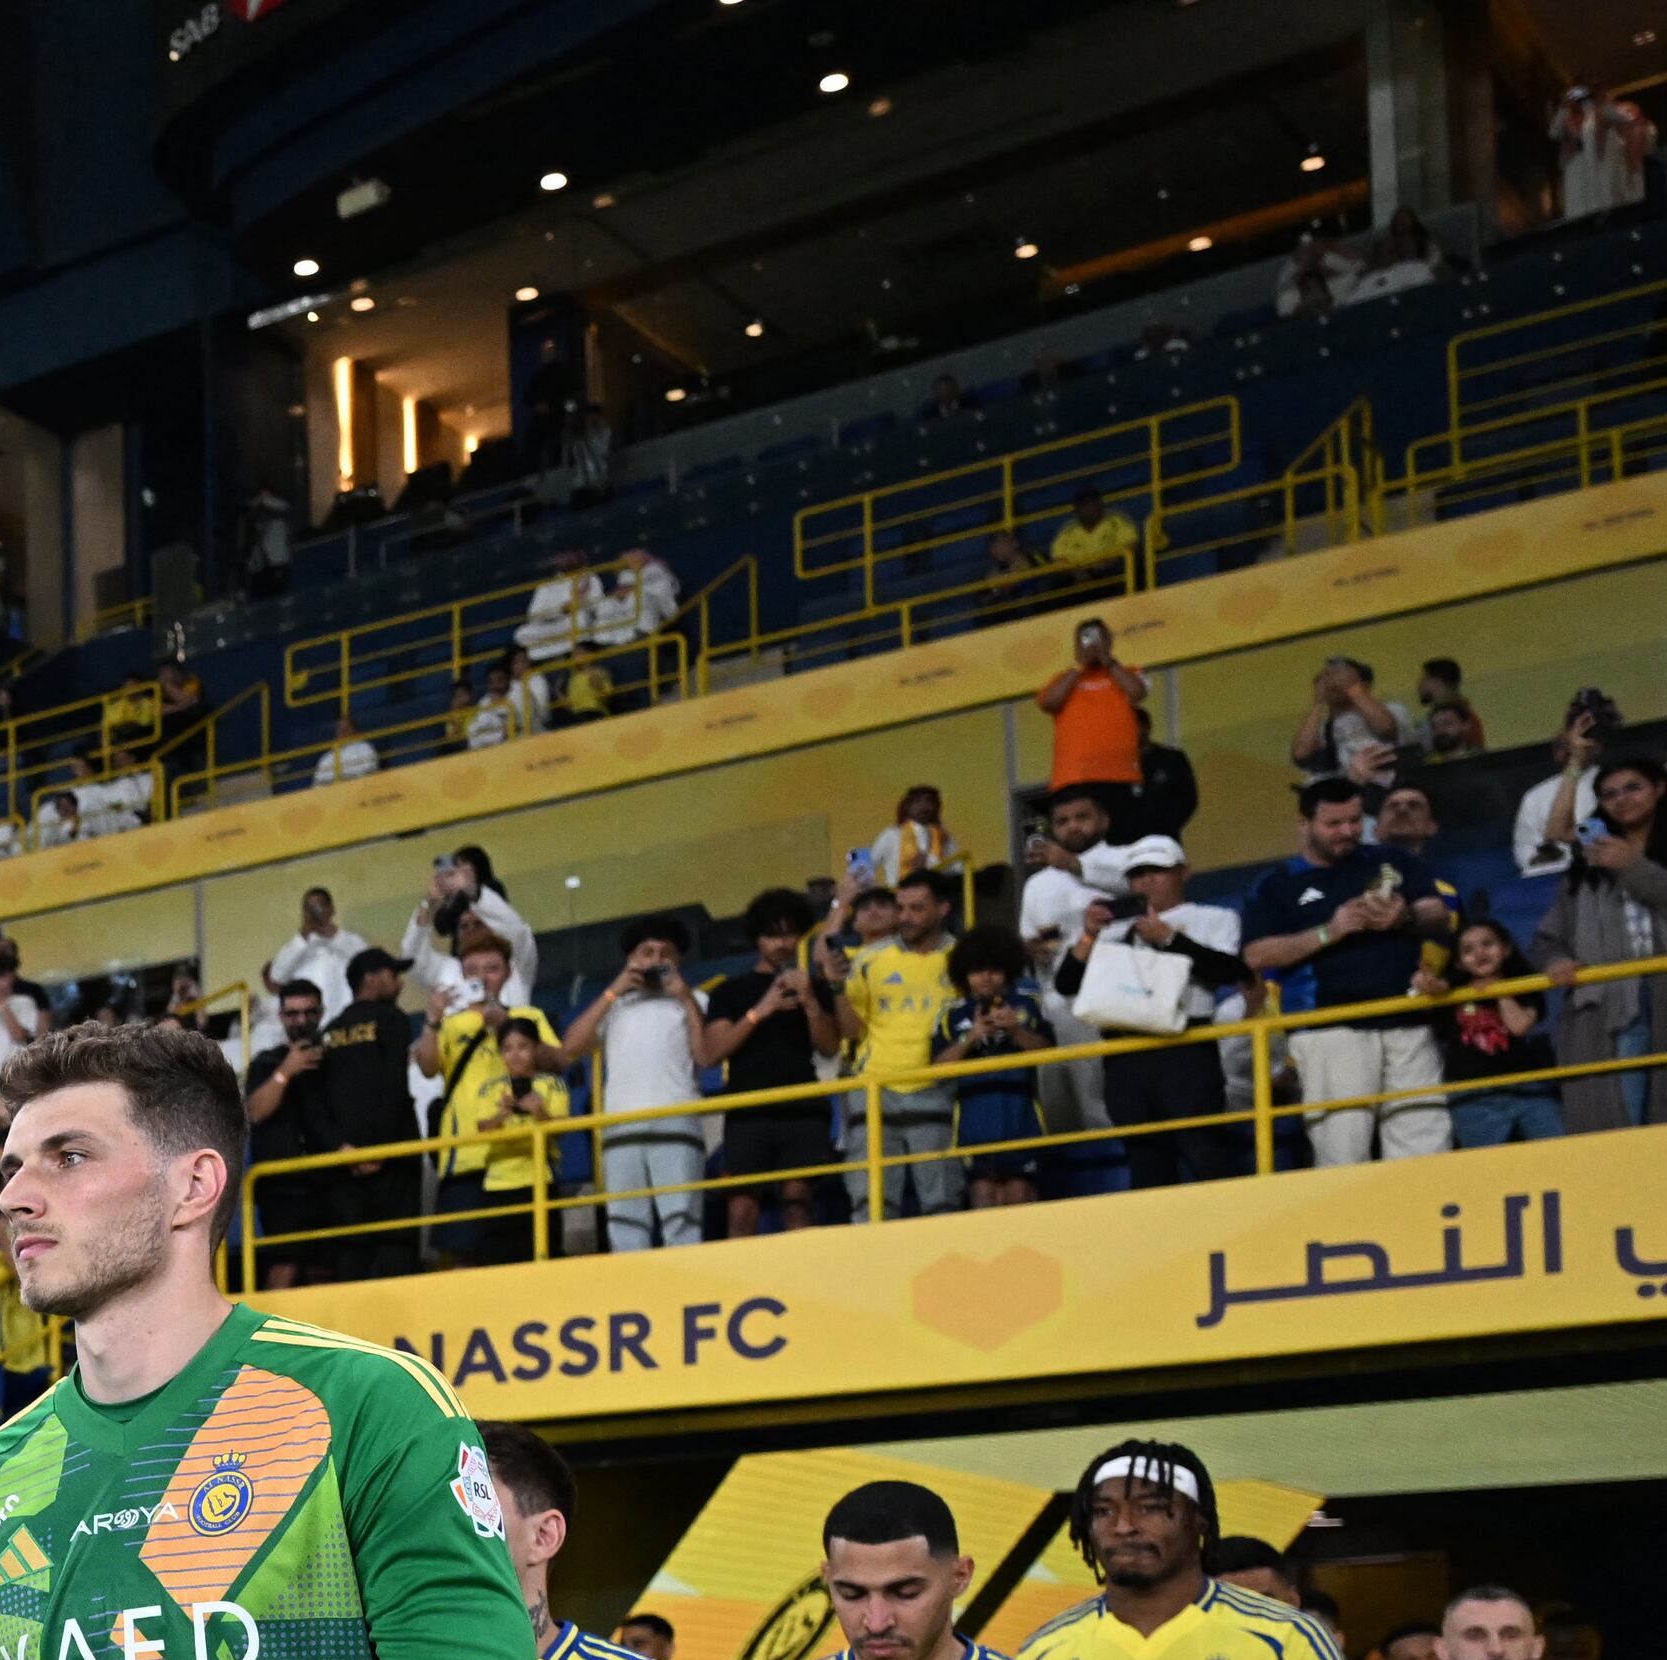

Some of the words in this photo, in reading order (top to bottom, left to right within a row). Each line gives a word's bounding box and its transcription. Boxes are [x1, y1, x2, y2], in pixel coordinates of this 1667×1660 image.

[1196, 1189, 1563, 1329] النصر
[683, 1297, 789, 1367] FC
[473, 1481, 492, 1500] RSL
